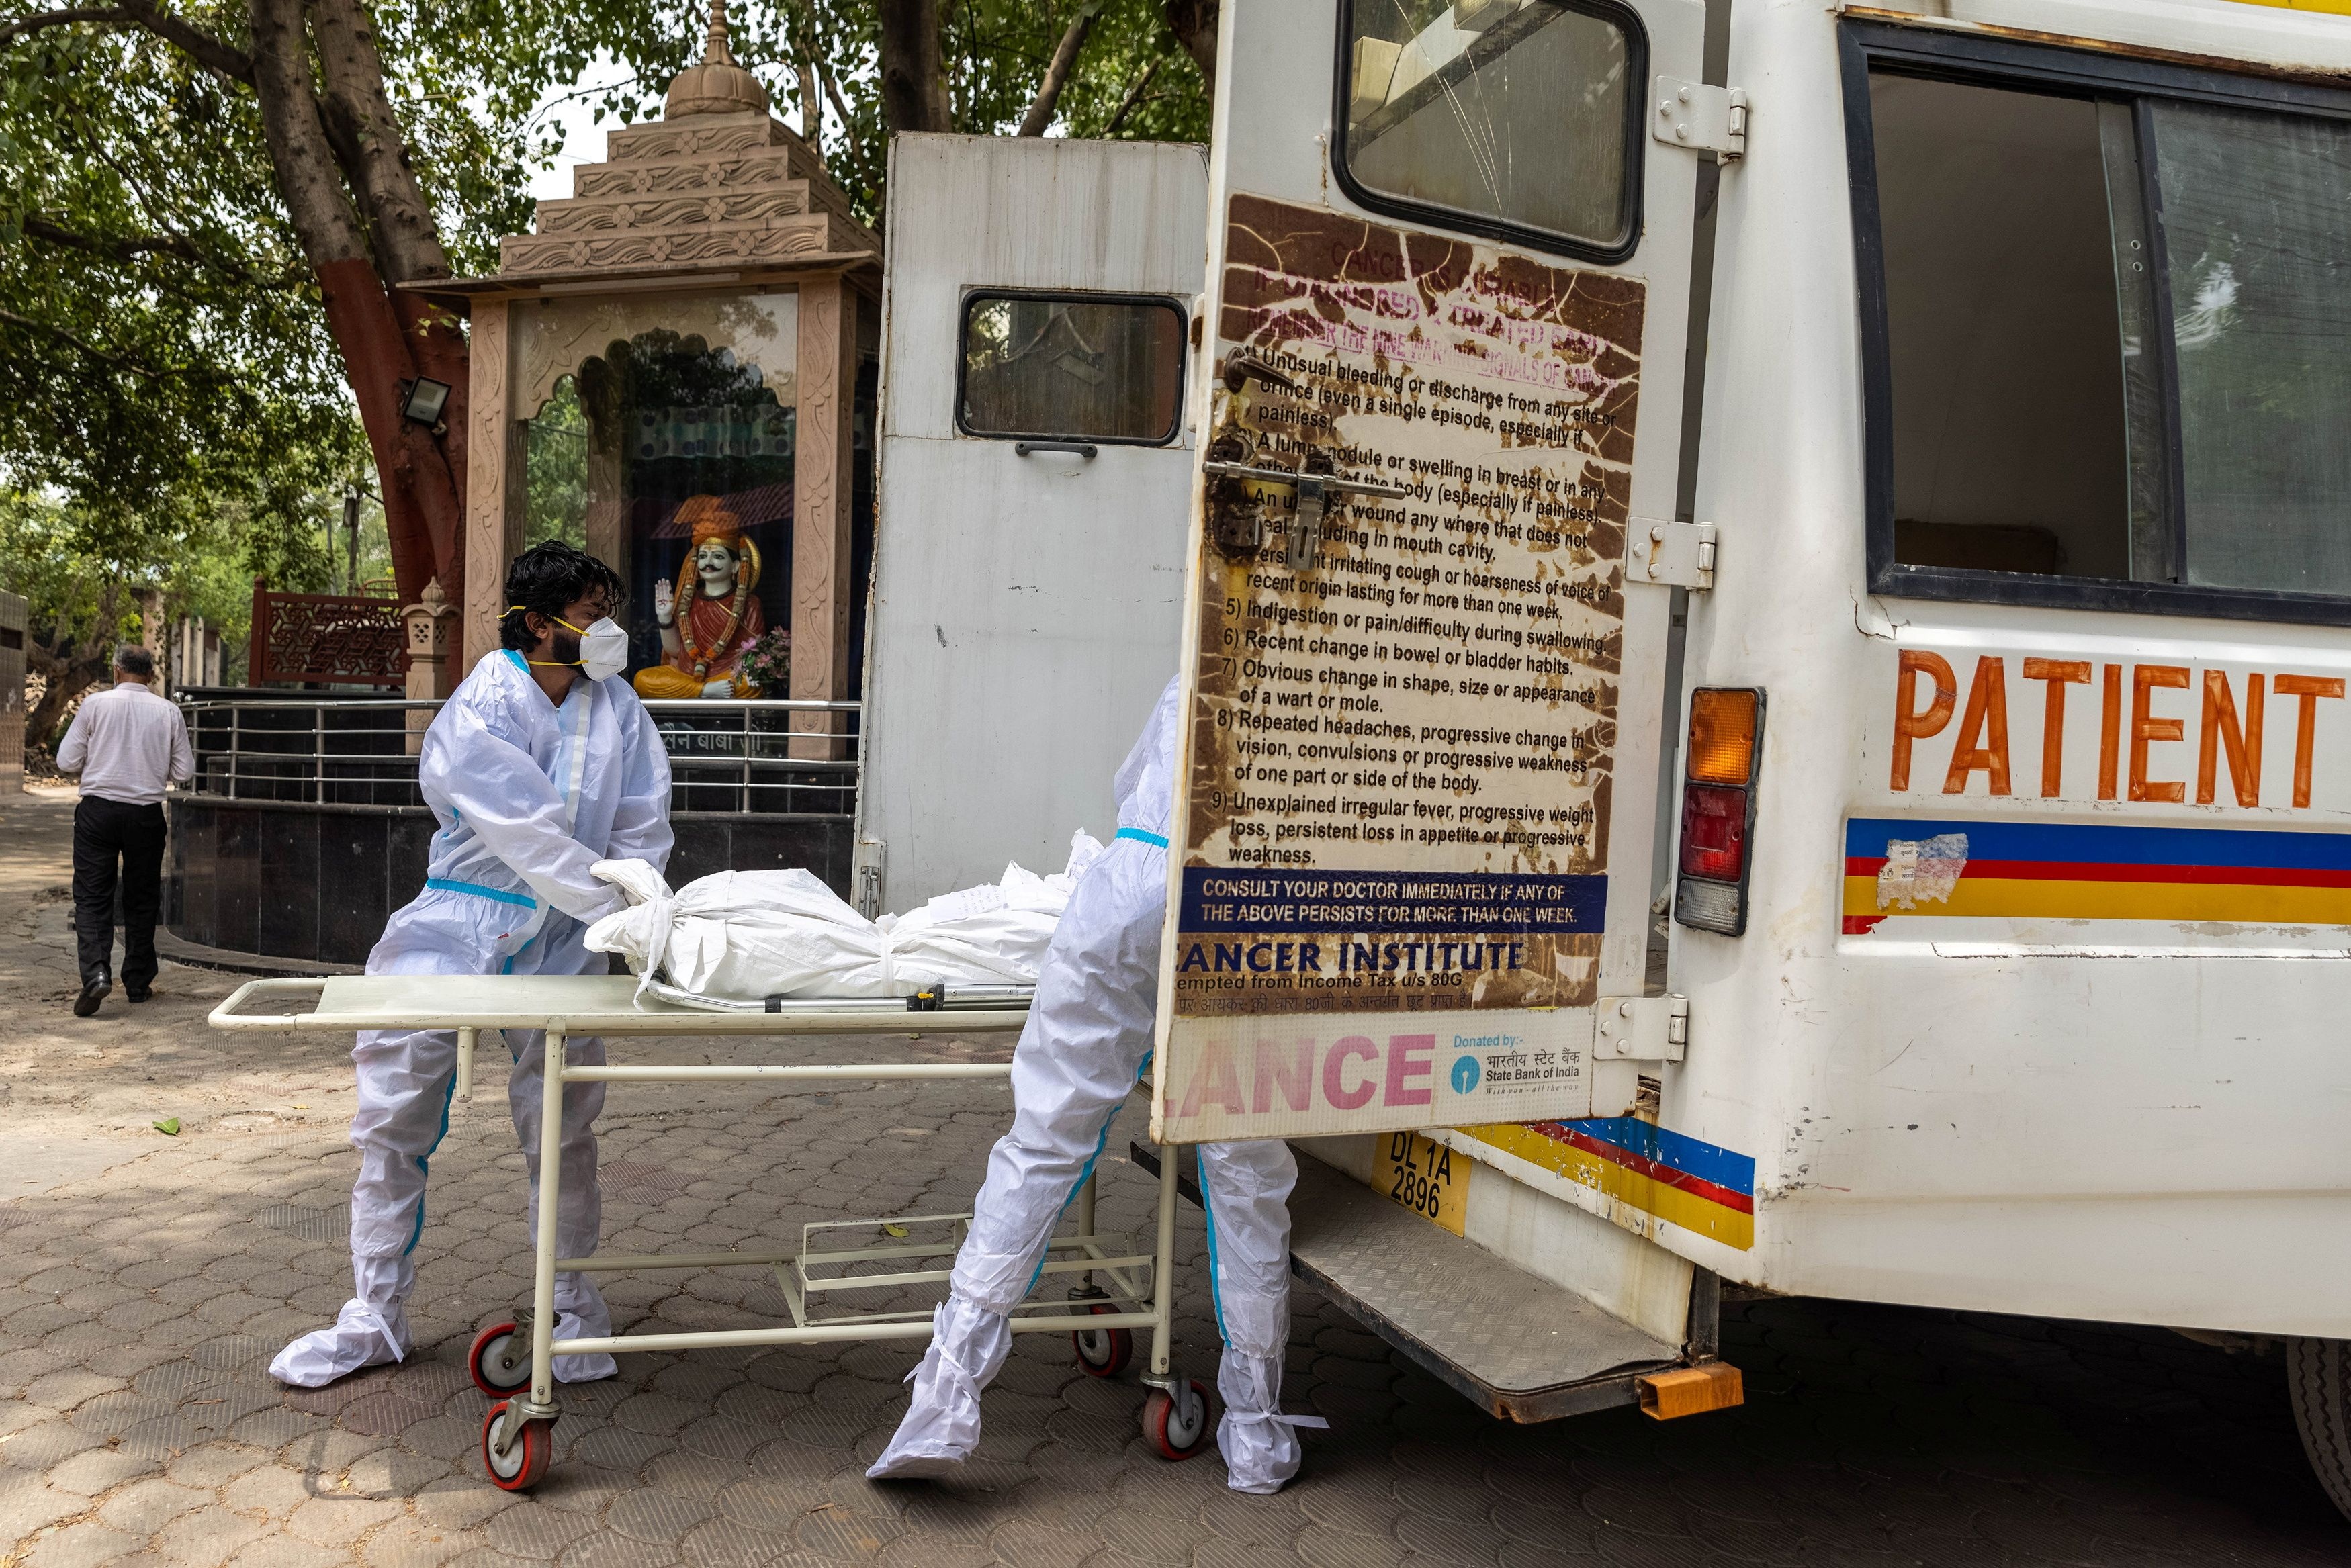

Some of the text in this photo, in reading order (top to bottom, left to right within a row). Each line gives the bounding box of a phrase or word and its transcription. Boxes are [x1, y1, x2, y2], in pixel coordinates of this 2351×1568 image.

[1263, 347, 1616, 426] Unusual bleeding or discharge from any site or
[1259, 404, 1337, 434] painless).
[1319, 384, 1583, 446] (even a single episode, especially if
[1374, 529, 1495, 563] in mouth cavity.
[1331, 553, 1611, 602] irritating cough or hoarseness of voice of
[1247, 573, 1562, 620] recent origin lasting for more than one week.
[1225, 598, 1606, 655] 5) Indigestion or pain/difficulty during swallowing.
[1223, 627, 1573, 676] 6) Recent change in bowel or bladder habits.
[1222, 658, 1595, 704] 7) Obvious change in shape, size or appearance
[1240, 686, 1384, 713] of a wart or mole.
[1217, 709, 1584, 751] 8) Repeated headaches, progressive change in
[1890, 649, 2346, 809] PATIENT
[1236, 737, 1587, 772] vision, convulsions or progressive weakness
[1235, 763, 1482, 795] of one part or side of the body.
[1212, 791, 1594, 826] 9) Unexplained irregular fever, progressive weight
[1231, 818, 1585, 849] loss, persistent loss in appetite or progressive
[1229, 845, 1316, 863] weakness.
[1203, 879, 1565, 901] CONSULT YOUR DOCTOR IMMEDIATELY IF ANY OF
[1202, 903, 1577, 923] THE ABOVE PERSISTS FOR MORE THAN ONE WEEK.
[1177, 942, 1524, 972] ANCER INSTITUTE
[1251, 975, 1292, 989] from
[1299, 974, 1362, 988] Income
[1368, 974, 1395, 987] Tax
[1402, 974, 1425, 987] u/s
[1431, 973, 1462, 986] 80G
[1251, 993, 1268, 1011] की
[1341, 990, 1354, 1009] के
[1454, 1034, 1499, 1048] Donated
[1487, 1047, 1581, 1068] भारतीय स्टेट बैंक
[1164, 1033, 1436, 1118] ANCE
[1486, 1066, 1579, 1082] State Bank of India
[1486, 1086, 1505, 1095] With
[1390, 1131, 1450, 1186] DL 1A
[1391, 1166, 1440, 1219] 2896
